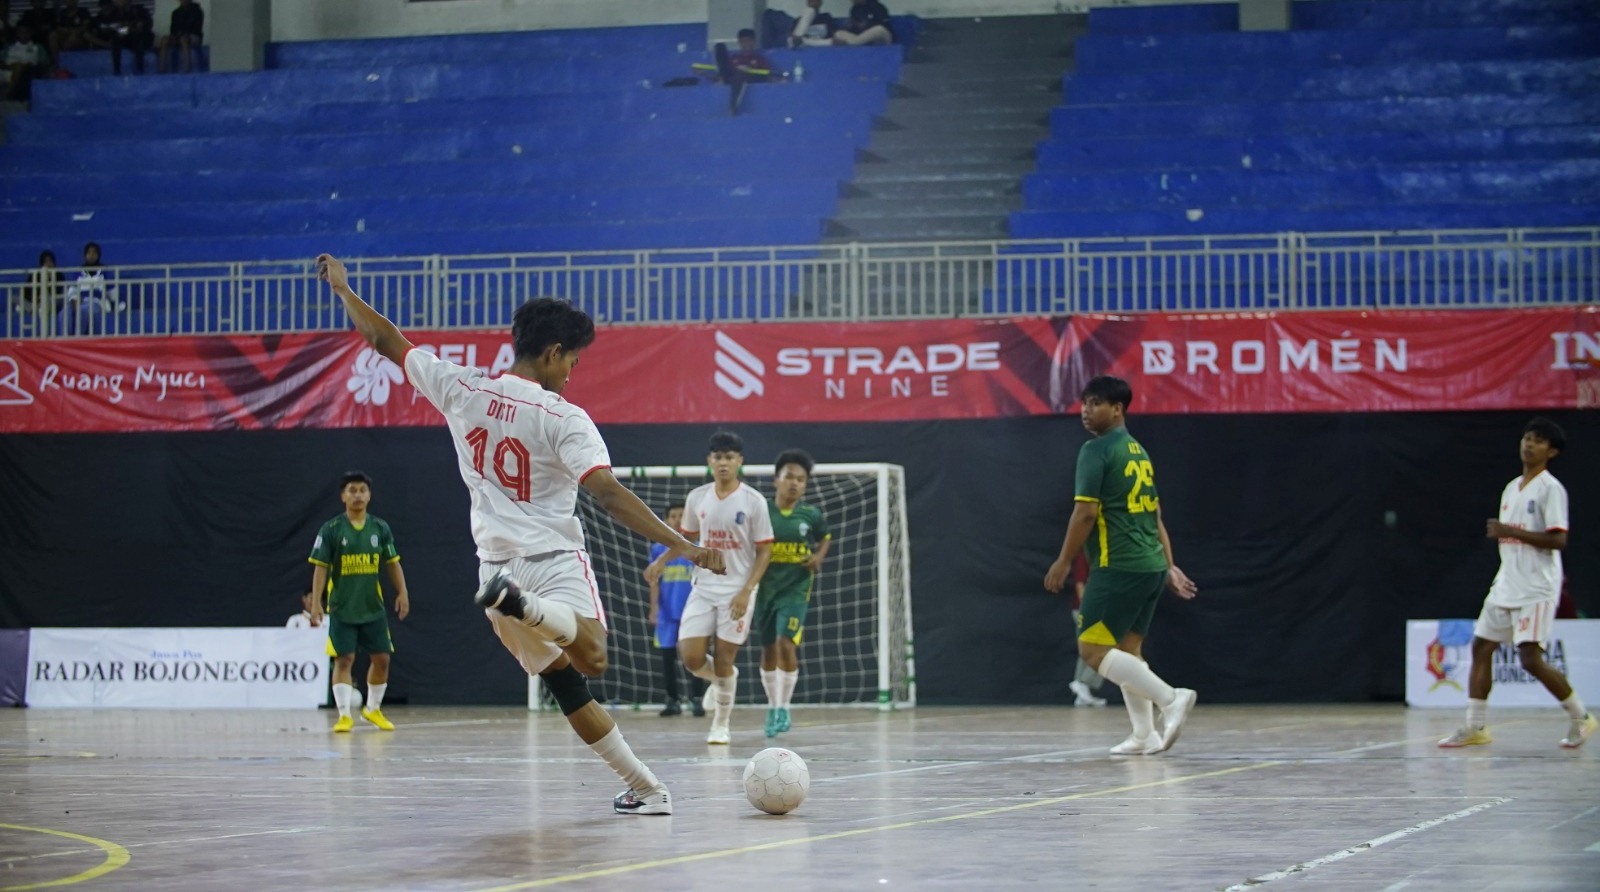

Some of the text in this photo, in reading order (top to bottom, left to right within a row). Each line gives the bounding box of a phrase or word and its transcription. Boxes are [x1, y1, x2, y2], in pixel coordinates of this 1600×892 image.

[776, 343, 999, 375] STRADE
[39, 363, 205, 404] Ruang Nyuci
[825, 376, 949, 399] NINE
[465, 427, 531, 503] 19
[35, 660, 319, 683] RADAR BOJONEGORO
